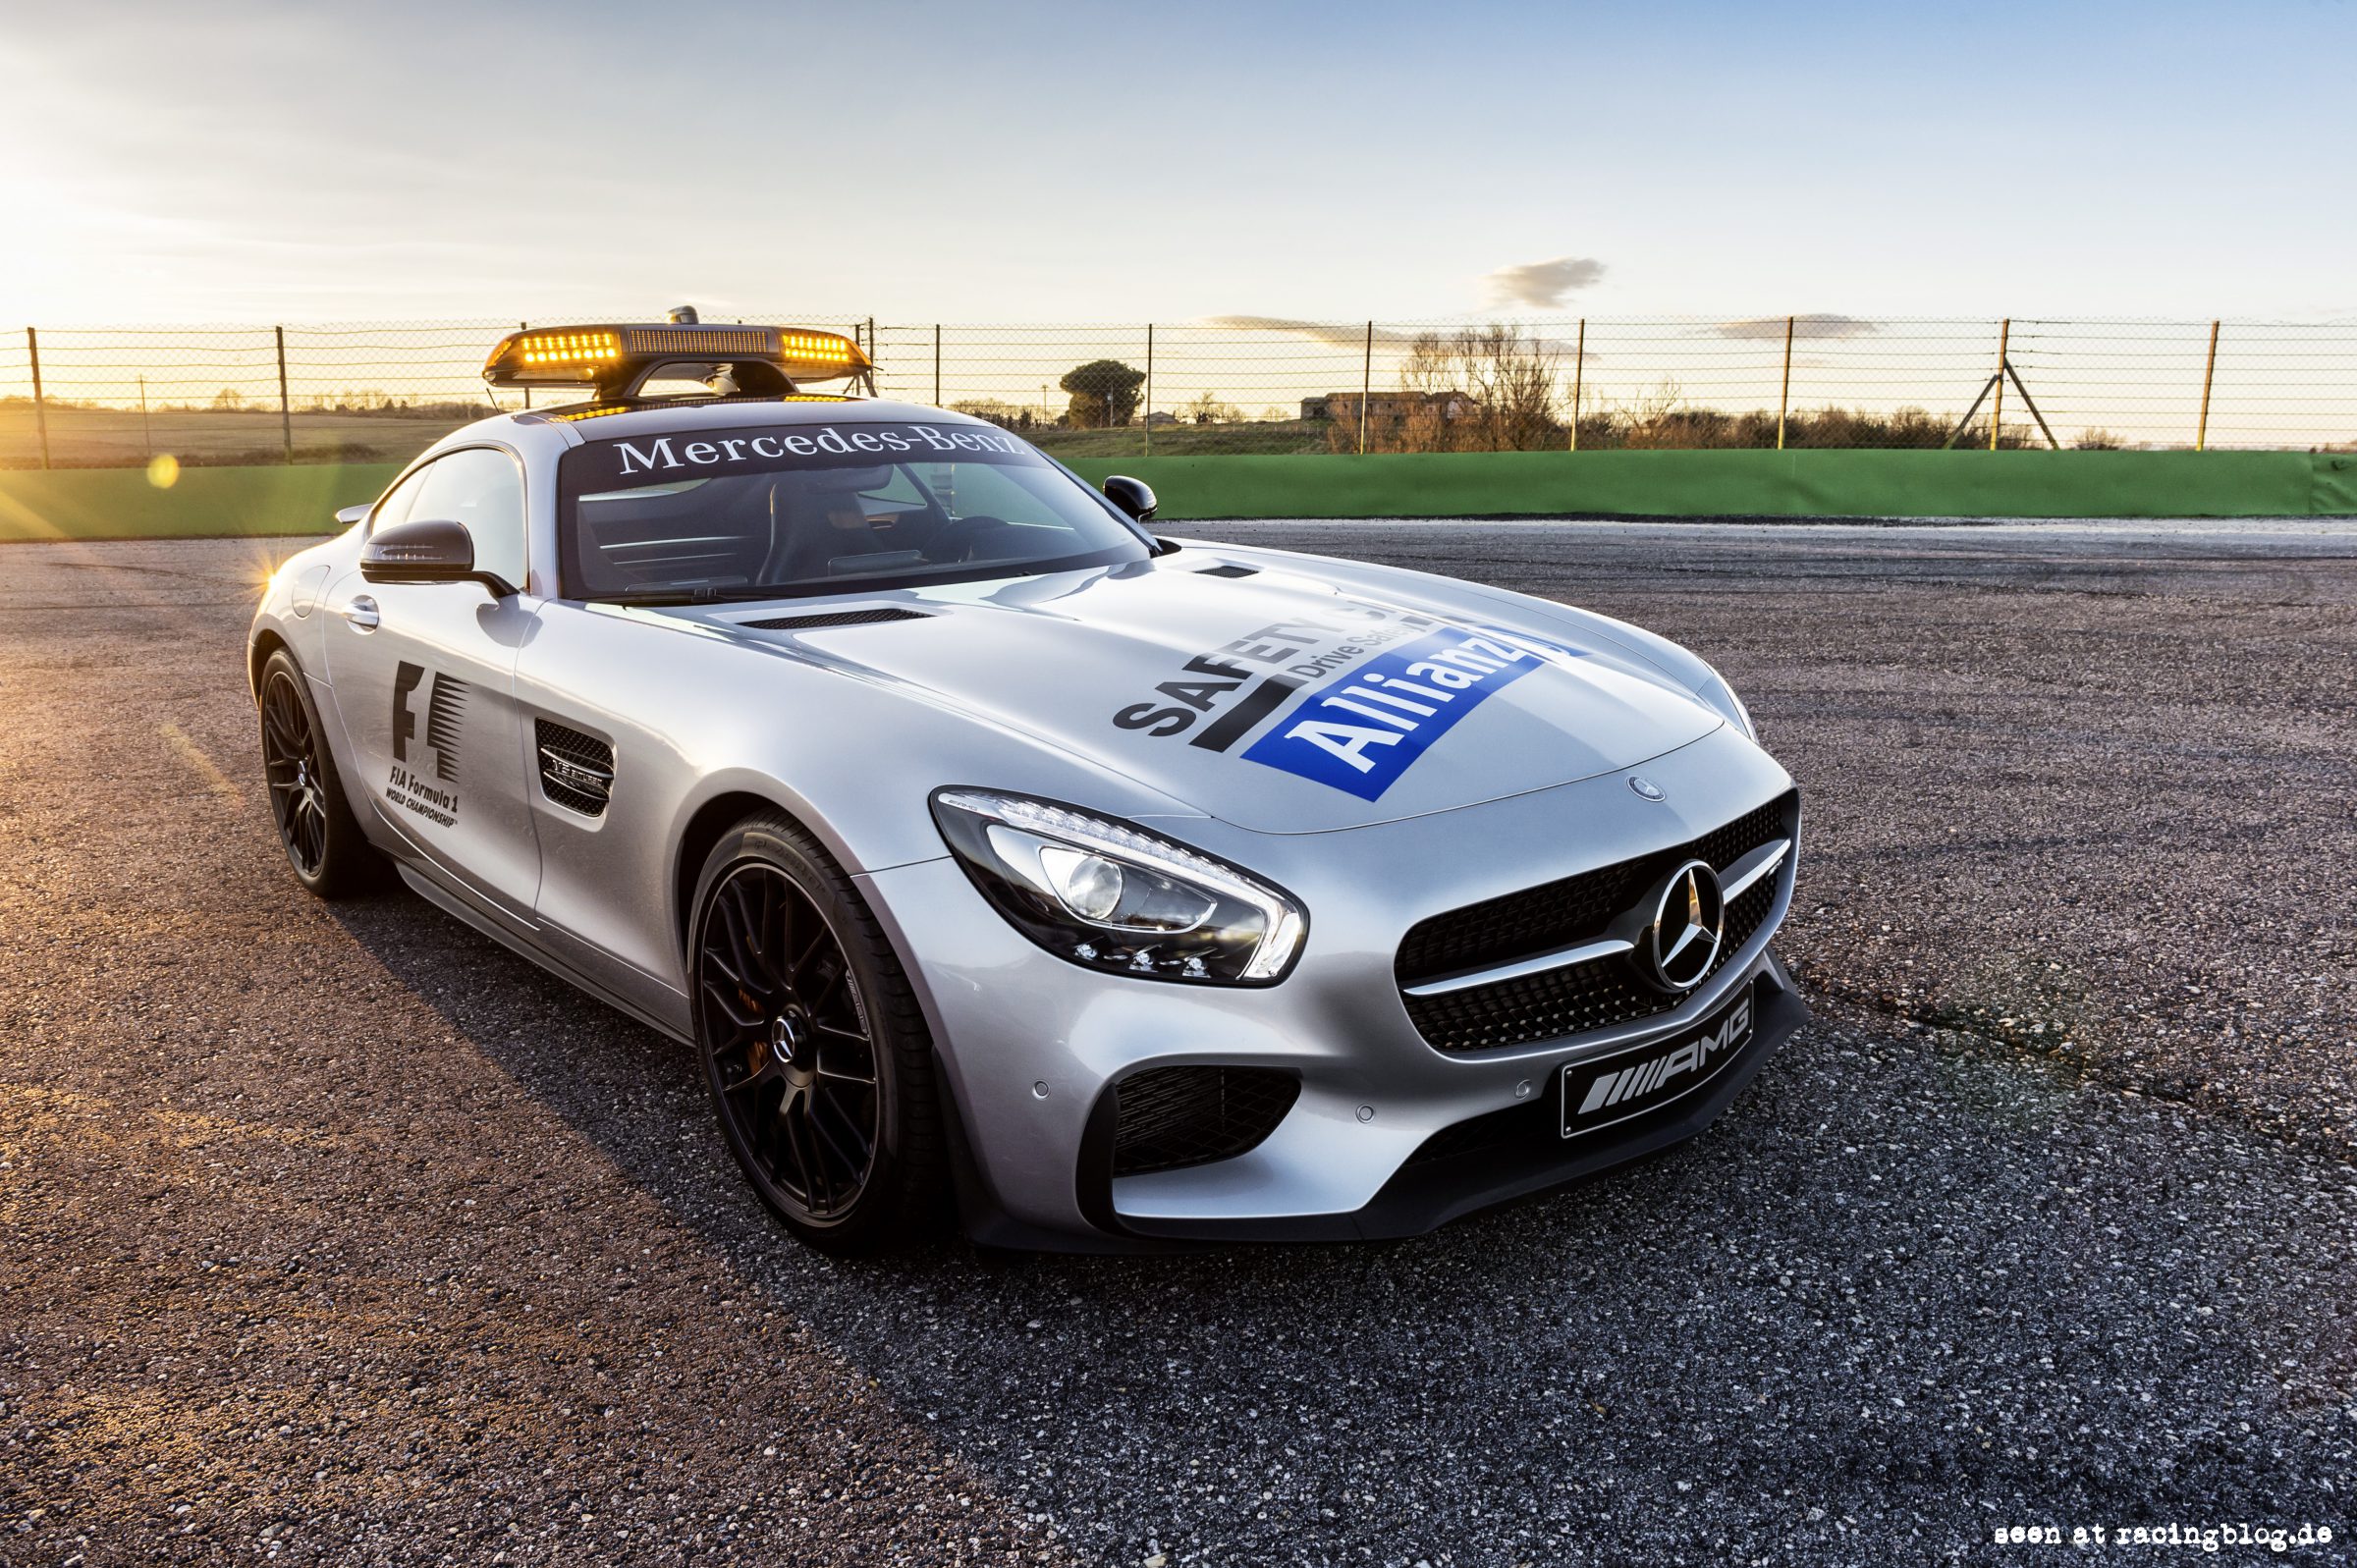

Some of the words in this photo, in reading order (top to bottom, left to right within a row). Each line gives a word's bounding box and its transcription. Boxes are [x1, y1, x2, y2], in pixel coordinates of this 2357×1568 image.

[613, 425, 1026, 474] Mercedes-Benz
[1112, 616, 1346, 737] SAFETY
[1286, 645, 1365, 679] Drive
[1285, 637, 1528, 774] Allianz
[385, 786, 407, 805] WORLD
[389, 765, 407, 788] FIA
[408, 774, 451, 810] Formula
[451, 795, 459, 813] 1
